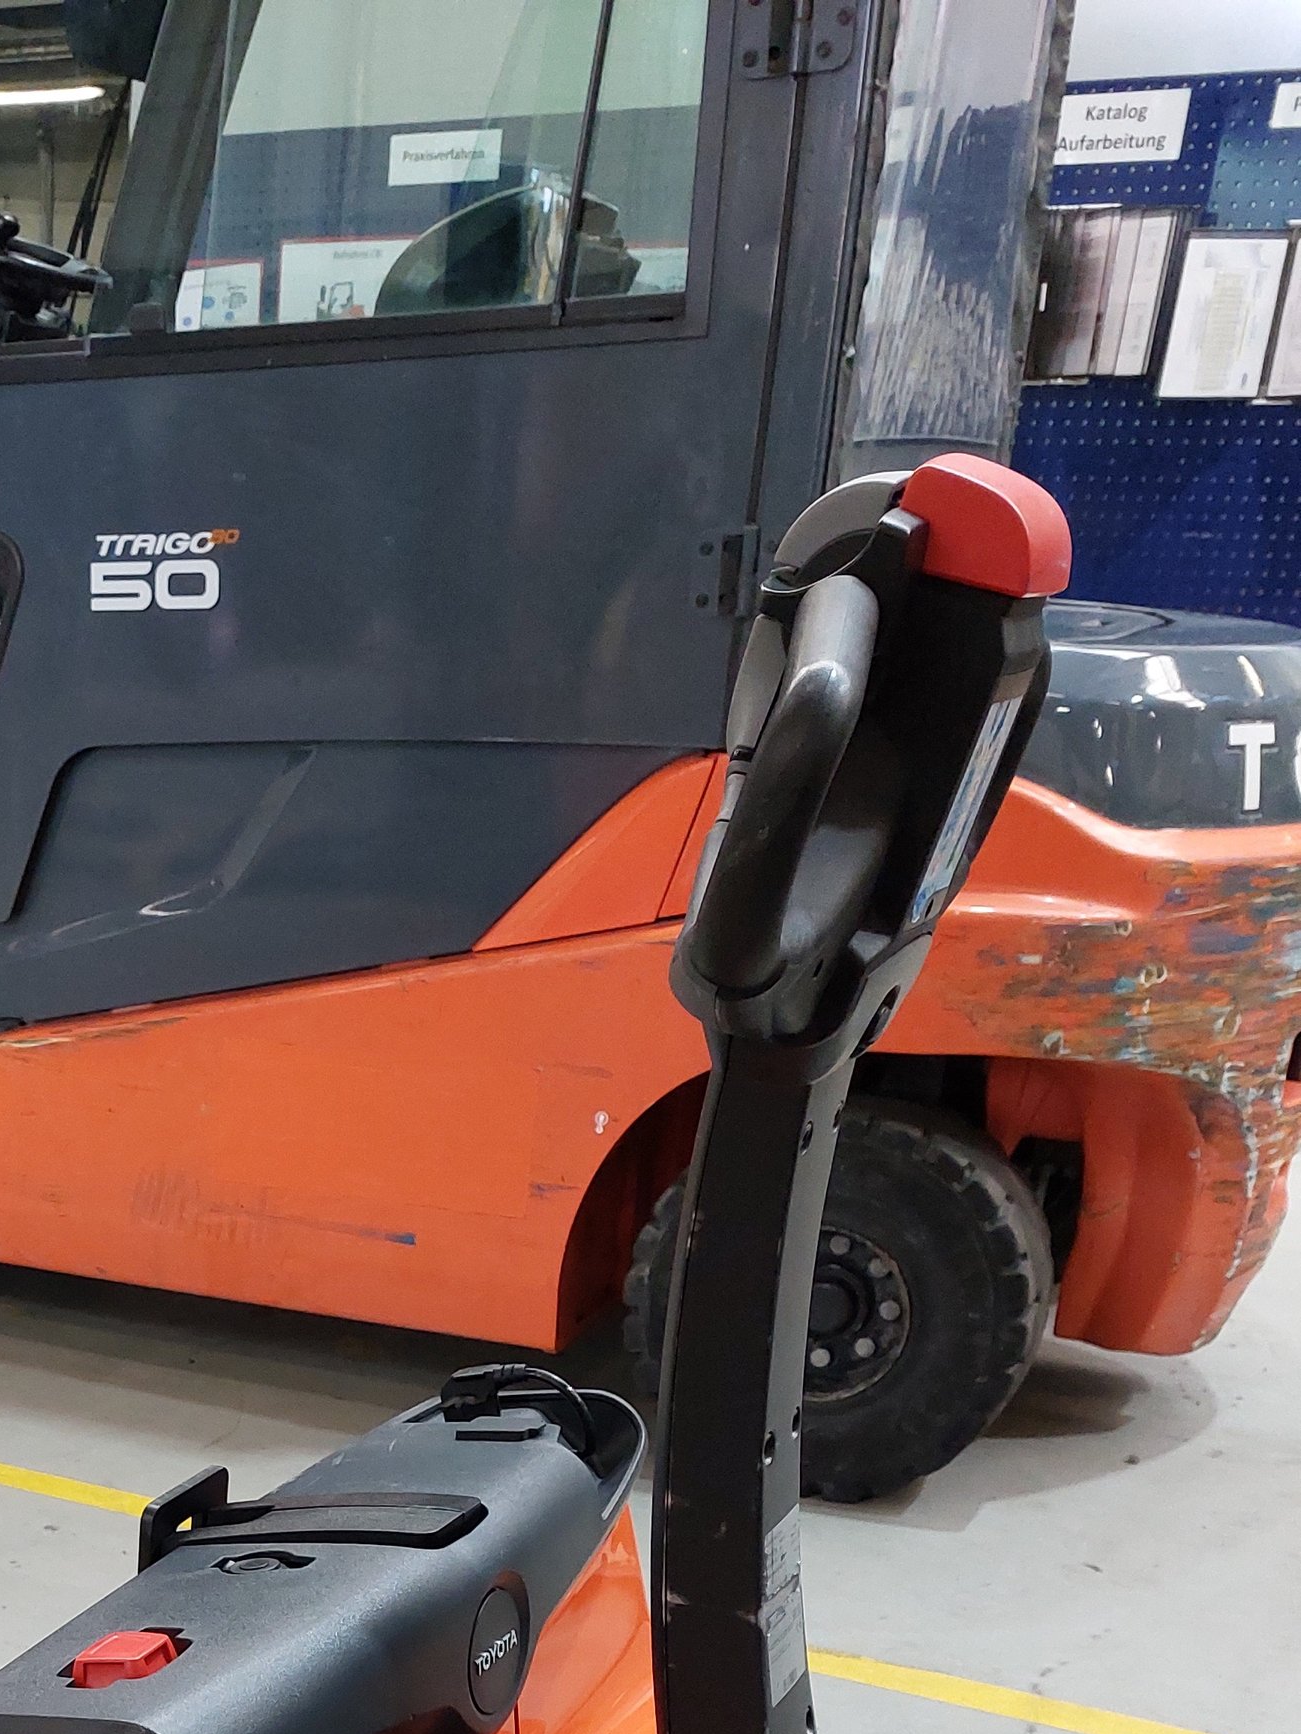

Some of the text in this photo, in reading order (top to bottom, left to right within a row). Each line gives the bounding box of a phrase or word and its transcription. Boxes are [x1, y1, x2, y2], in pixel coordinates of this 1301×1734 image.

[1085, 102, 1148, 122] Katalog
[1057, 133, 1167, 152] Aufarbeitung
[89, 558, 220, 612] 50
[474, 1629, 519, 1677] TOYOTA
